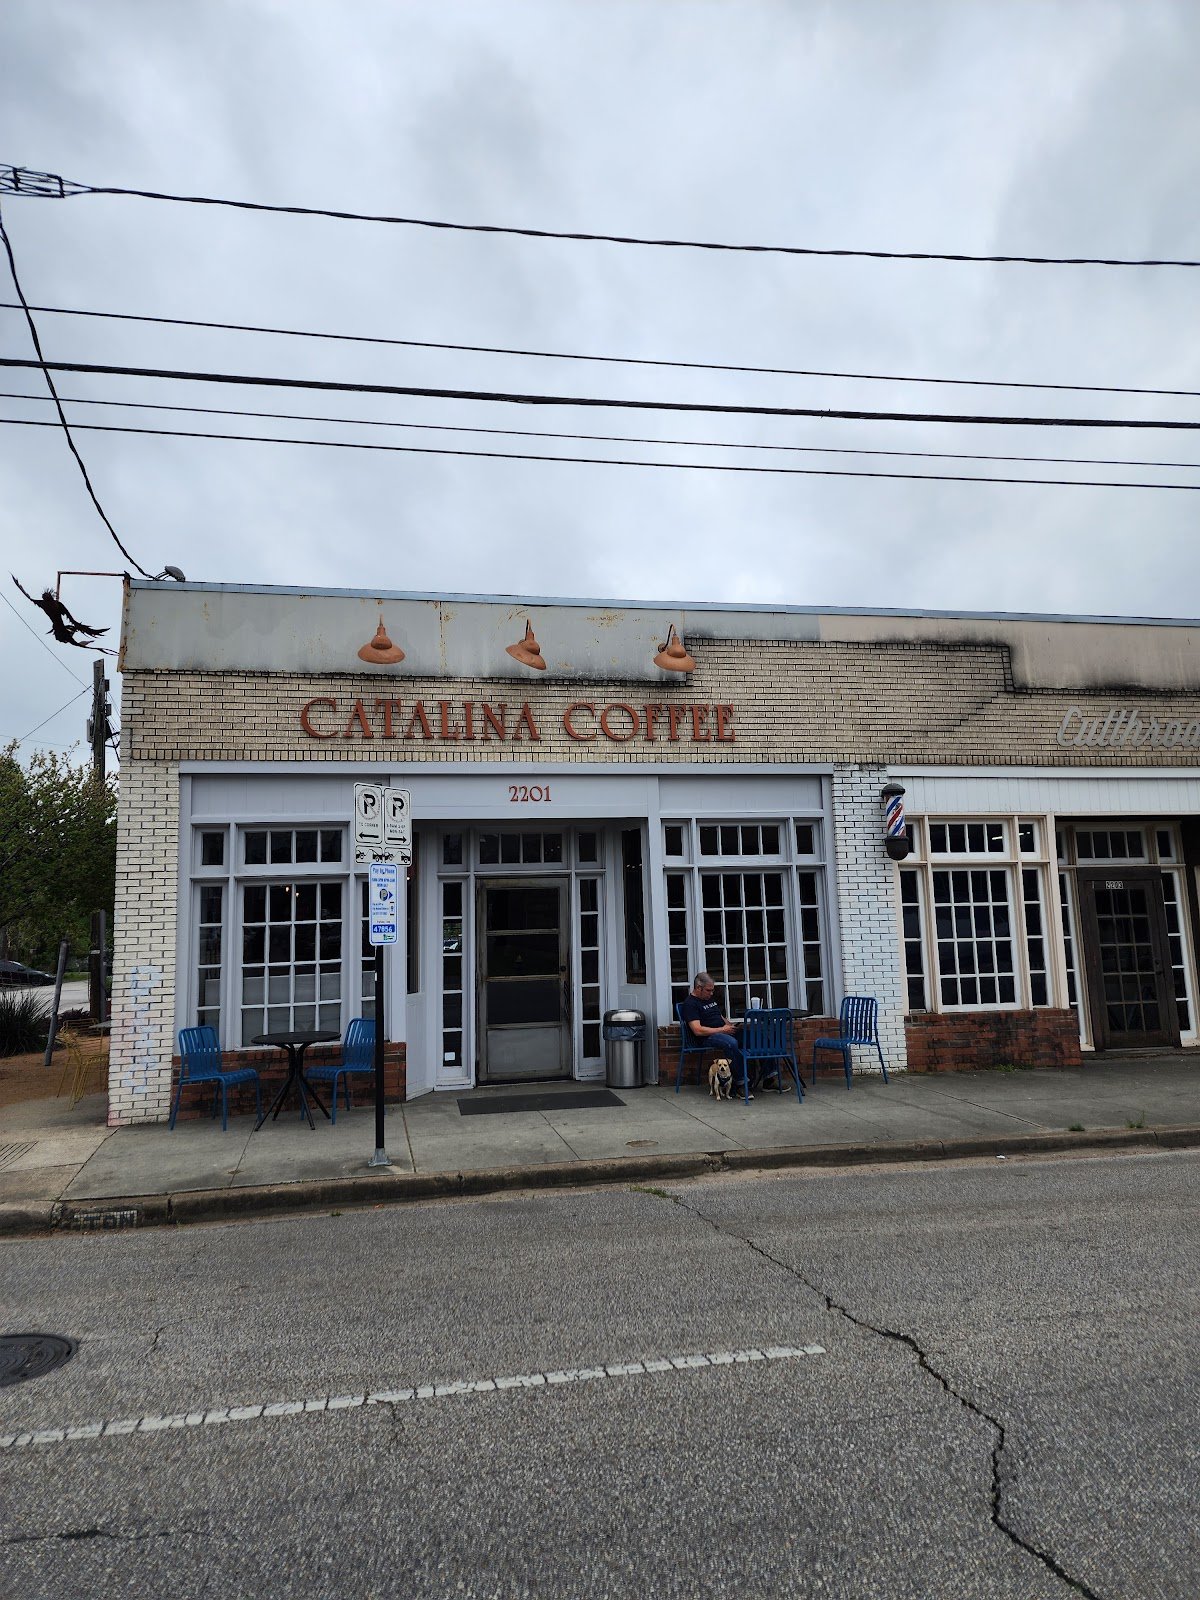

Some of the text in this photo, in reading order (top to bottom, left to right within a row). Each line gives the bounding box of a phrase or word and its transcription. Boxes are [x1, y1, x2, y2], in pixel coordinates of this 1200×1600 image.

[300, 697, 736, 742] CATALINA COFFEE
[508, 785, 552, 802] 2201
